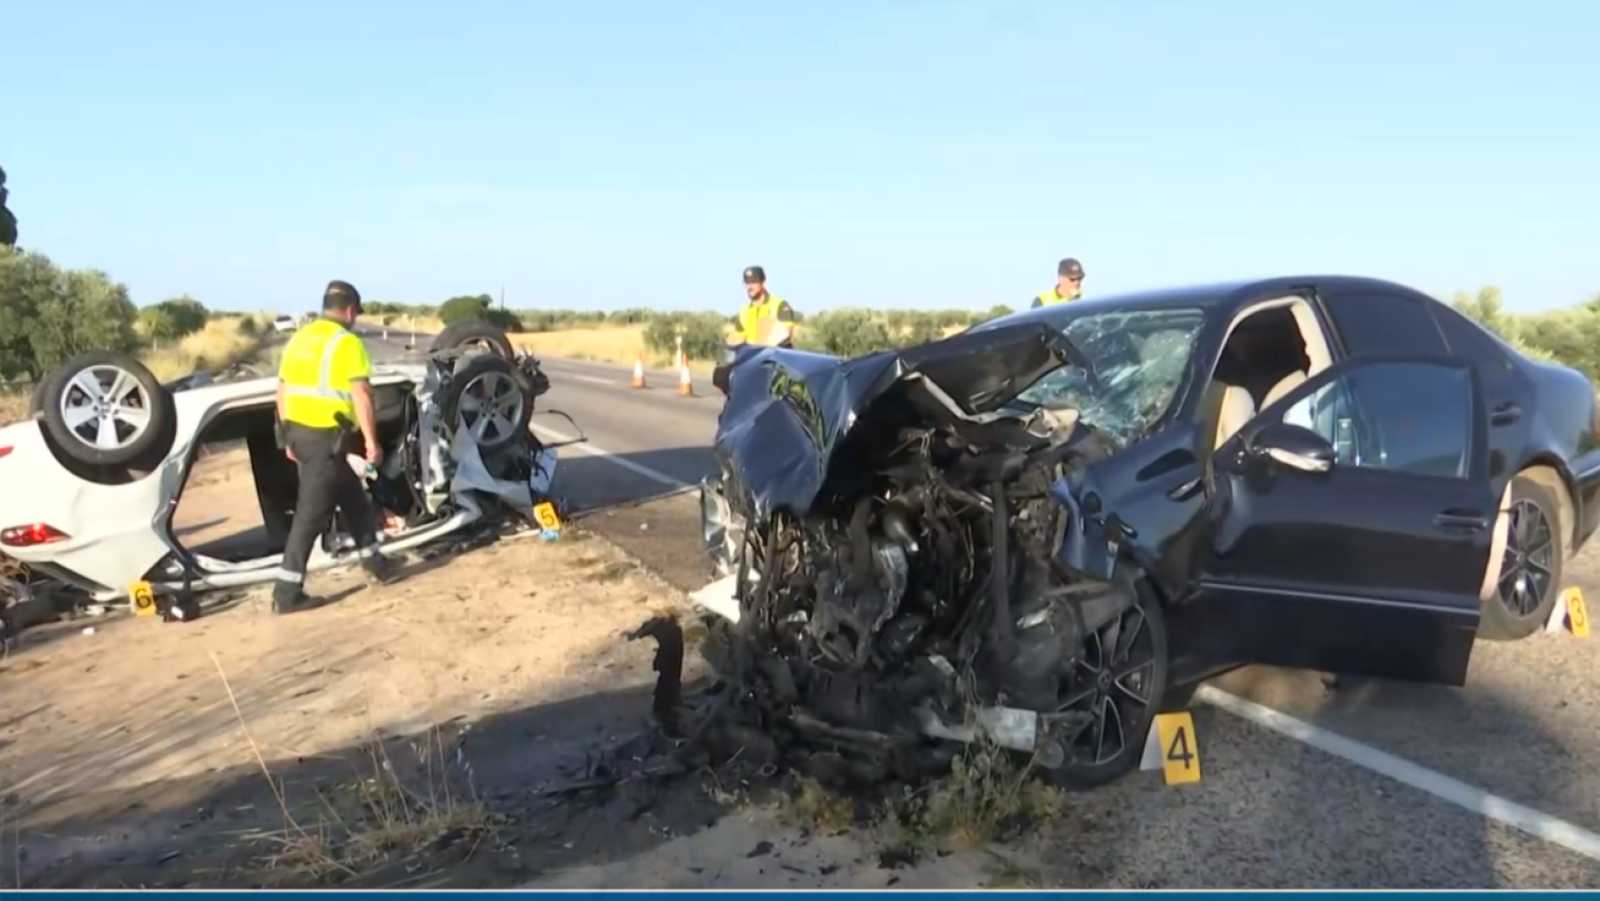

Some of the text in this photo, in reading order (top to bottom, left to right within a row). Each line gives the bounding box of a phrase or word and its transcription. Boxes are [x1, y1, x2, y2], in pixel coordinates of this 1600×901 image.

[541, 507, 555, 527] 5
[135, 588, 152, 609] 6
[1571, 596, 1585, 628] 3
[1167, 725, 1194, 770] 4
